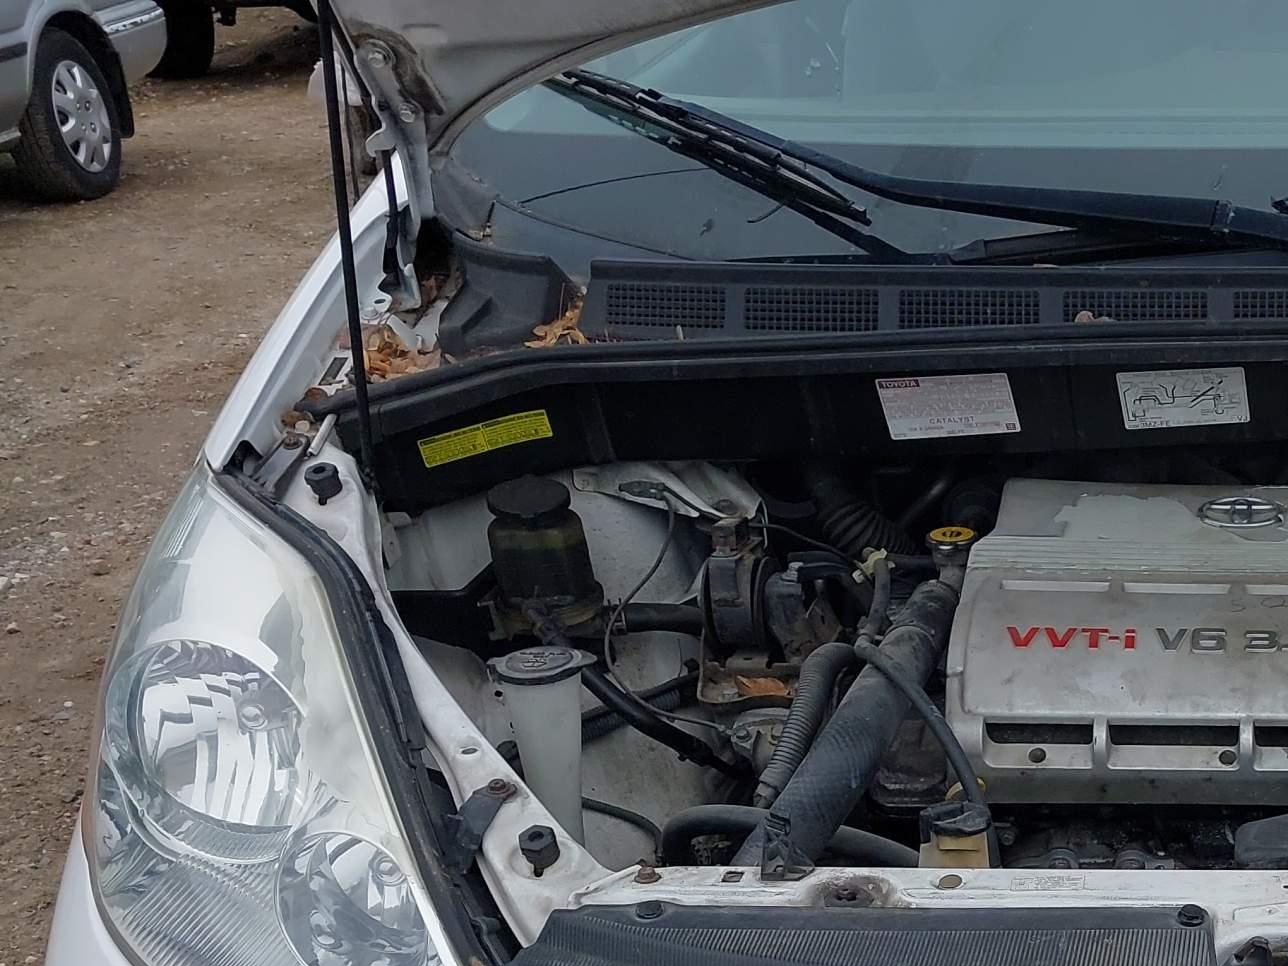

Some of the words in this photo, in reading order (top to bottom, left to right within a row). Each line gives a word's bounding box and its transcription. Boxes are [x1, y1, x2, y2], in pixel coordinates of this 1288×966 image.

[929, 416, 975, 425] CATALYST
[1007, 627, 1137, 650] VVT-i
[1156, 627, 1227, 654] V6
